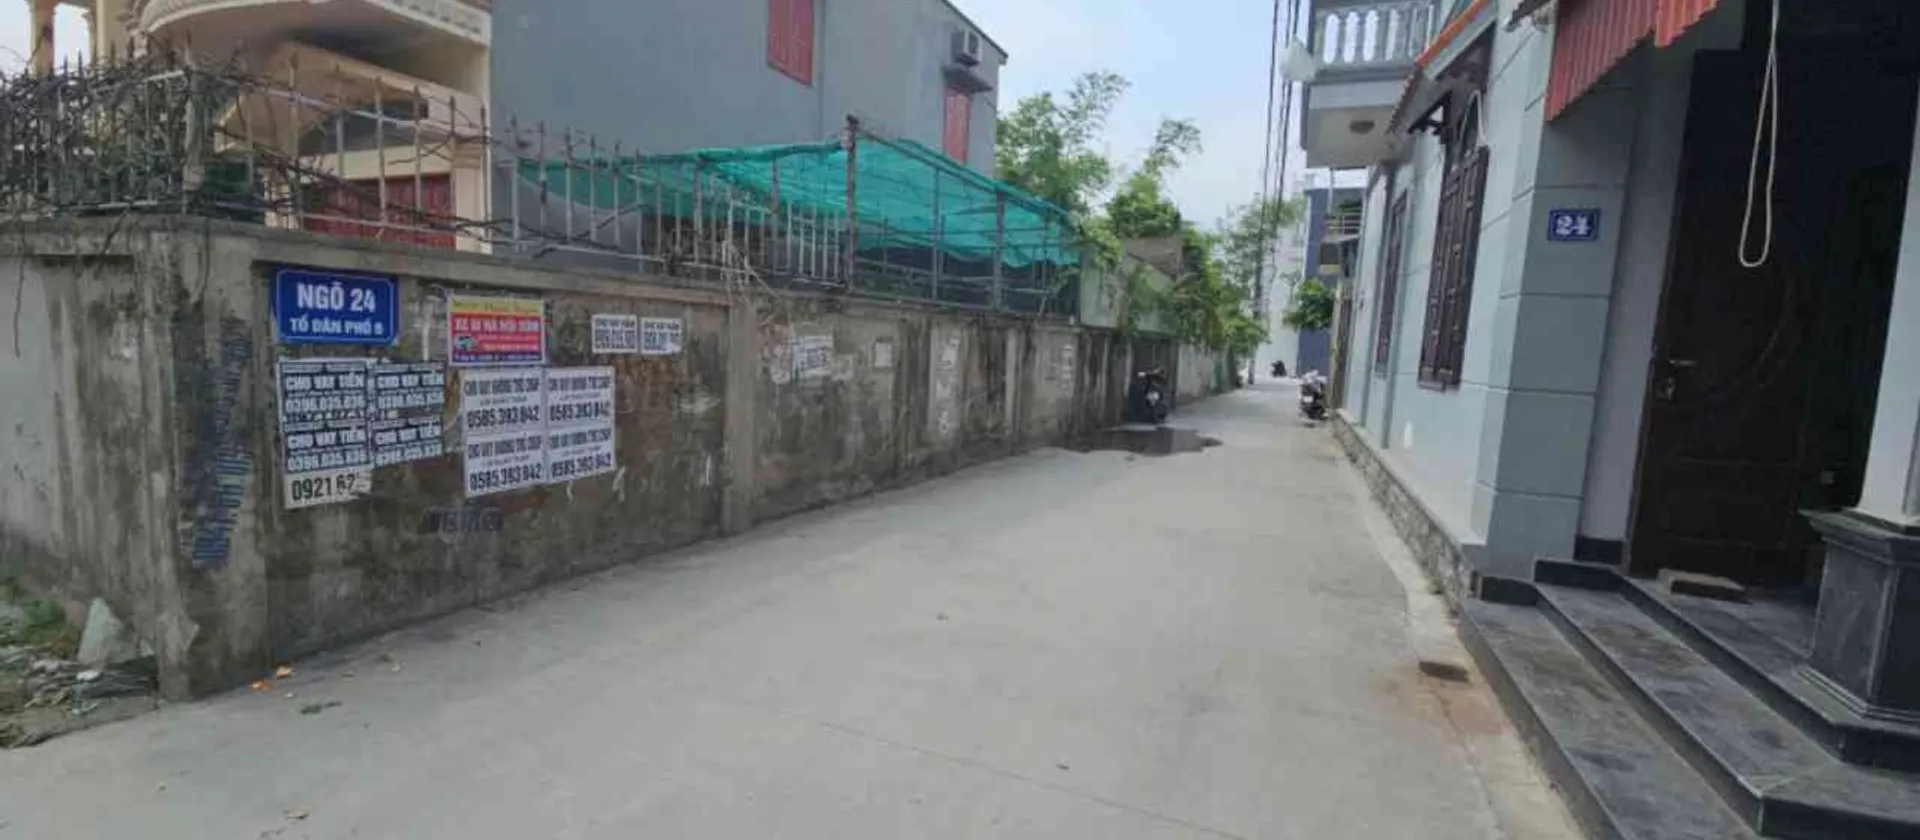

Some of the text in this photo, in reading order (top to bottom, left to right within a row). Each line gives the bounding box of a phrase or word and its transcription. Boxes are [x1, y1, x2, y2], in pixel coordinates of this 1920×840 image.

[1556, 215, 1591, 235] 24
[297, 281, 376, 313] NGÕ 24
[286, 375, 312, 391] CHO
[313, 375, 335, 389] VAY
[377, 375, 400, 389] CHO
[401, 374, 419, 387] VAY
[287, 433, 314, 449] CHO
[315, 431, 337, 447] VAY
[375, 431, 397, 445] CHO
